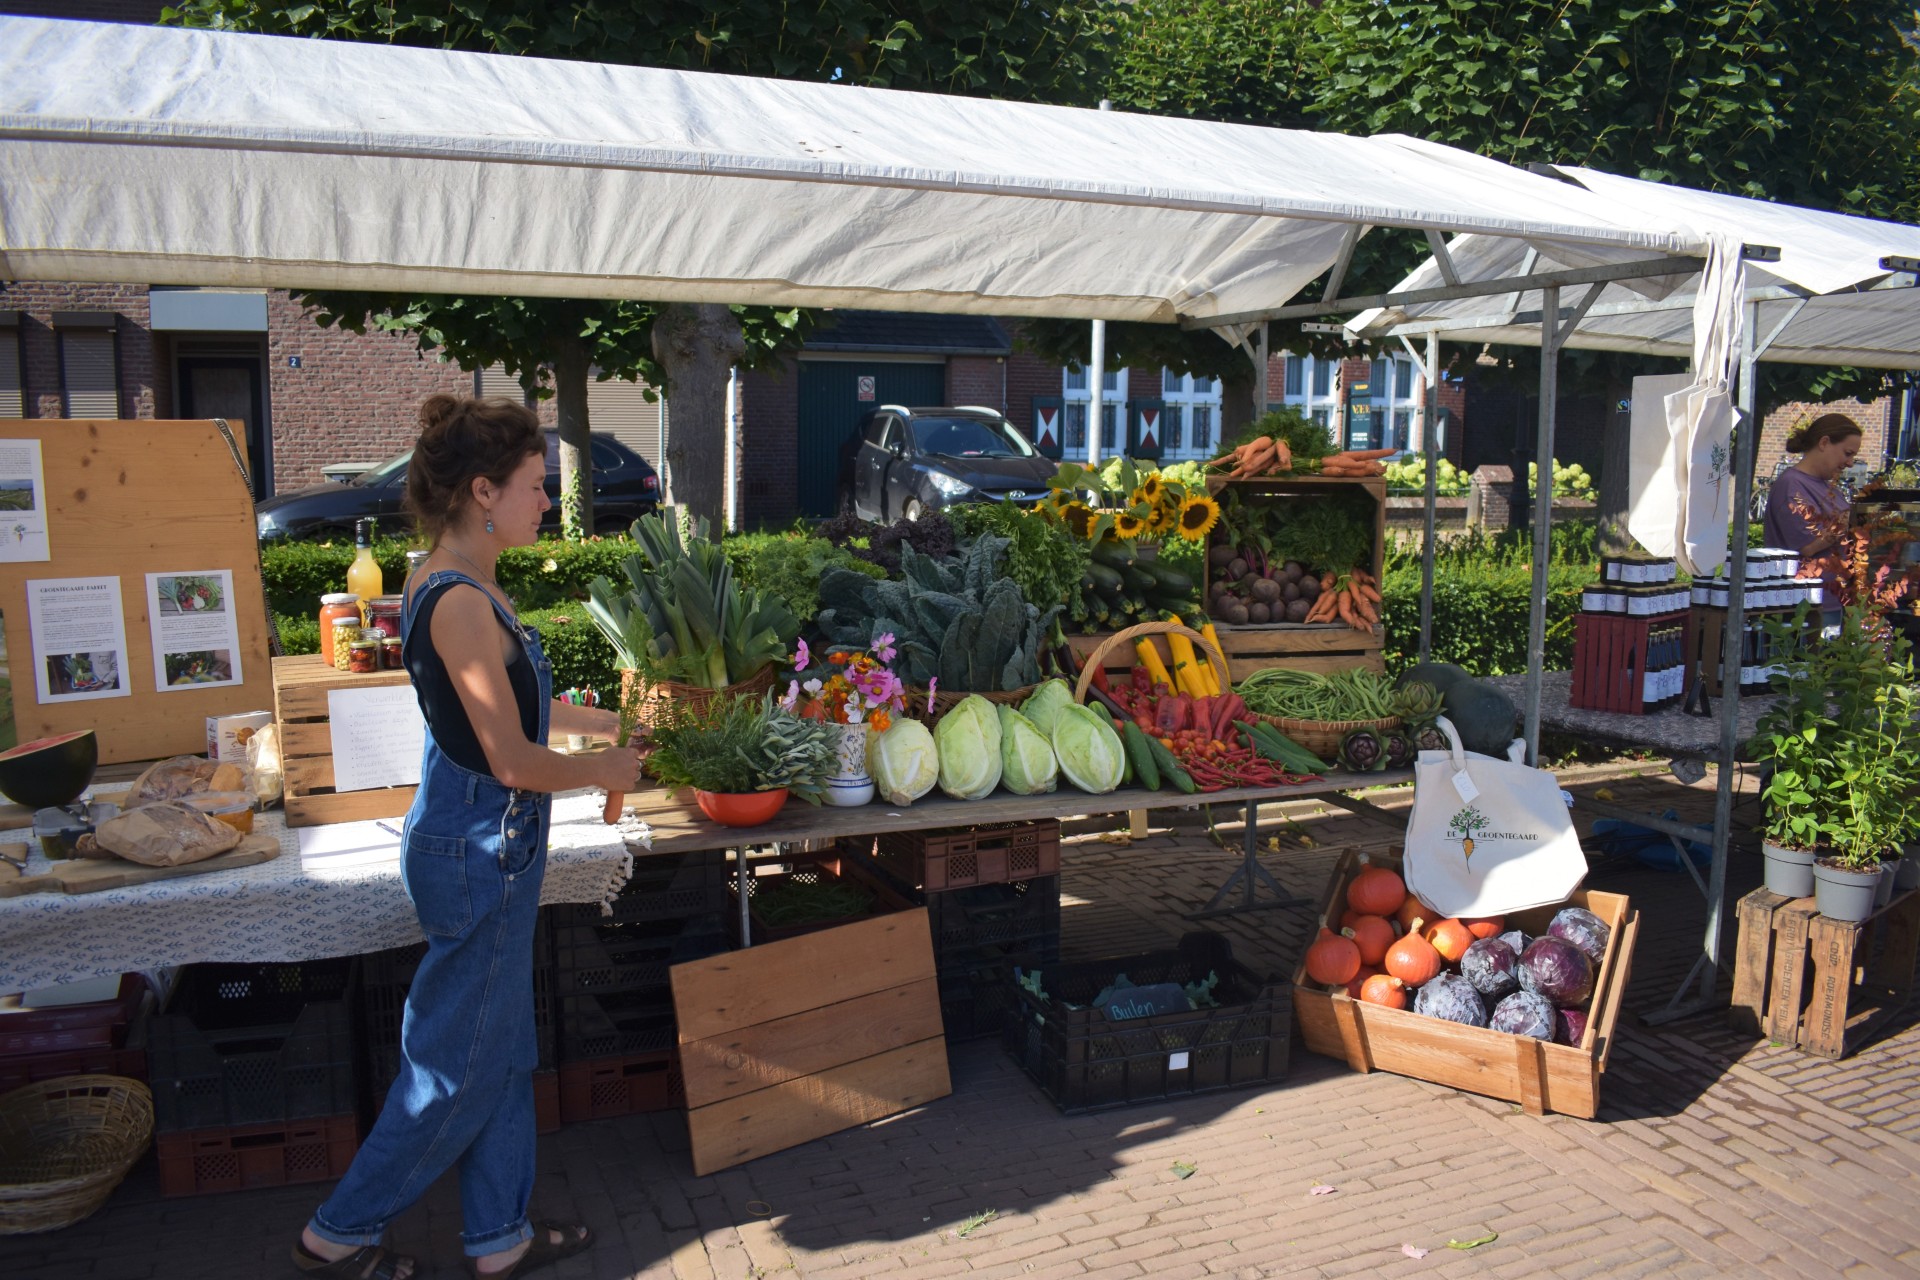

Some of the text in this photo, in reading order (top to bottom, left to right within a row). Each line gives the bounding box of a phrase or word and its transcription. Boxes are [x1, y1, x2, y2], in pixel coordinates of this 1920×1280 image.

[291, 358, 296, 366] 2
[1477, 832, 1538, 840] GROENTEGAARD
[1821, 976, 1836, 1039] ROERMONDSE
